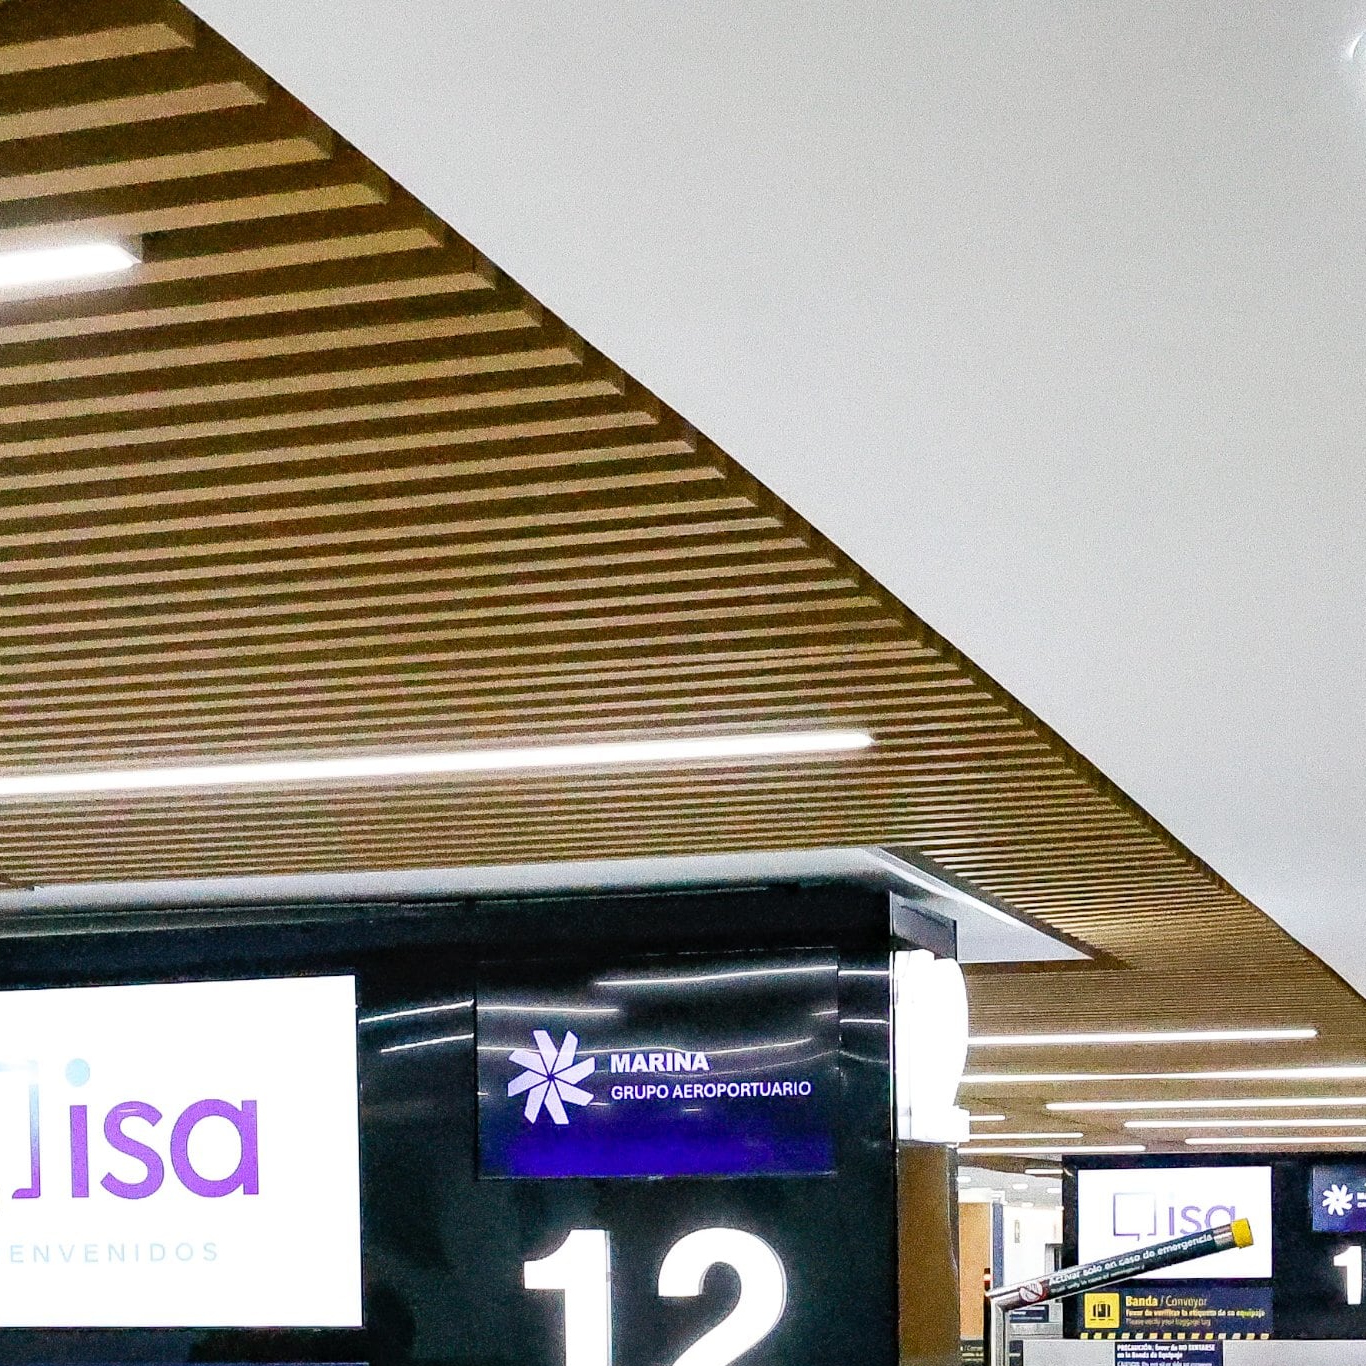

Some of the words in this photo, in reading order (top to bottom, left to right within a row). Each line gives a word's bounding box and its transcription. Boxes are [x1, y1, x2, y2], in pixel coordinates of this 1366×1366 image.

[610, 1052, 709, 1074] MARINA
[611, 1084, 668, 1100] GRUPO
[673, 1081, 811, 1099] AEROPORTUARIO
[69, 1058, 259, 1199] isa
[1157, 1234, 1213, 1256] emergencia
[1125, 1295, 1158, 1306] Banda
[1165, 1295, 1207, 1310] Conveyor
